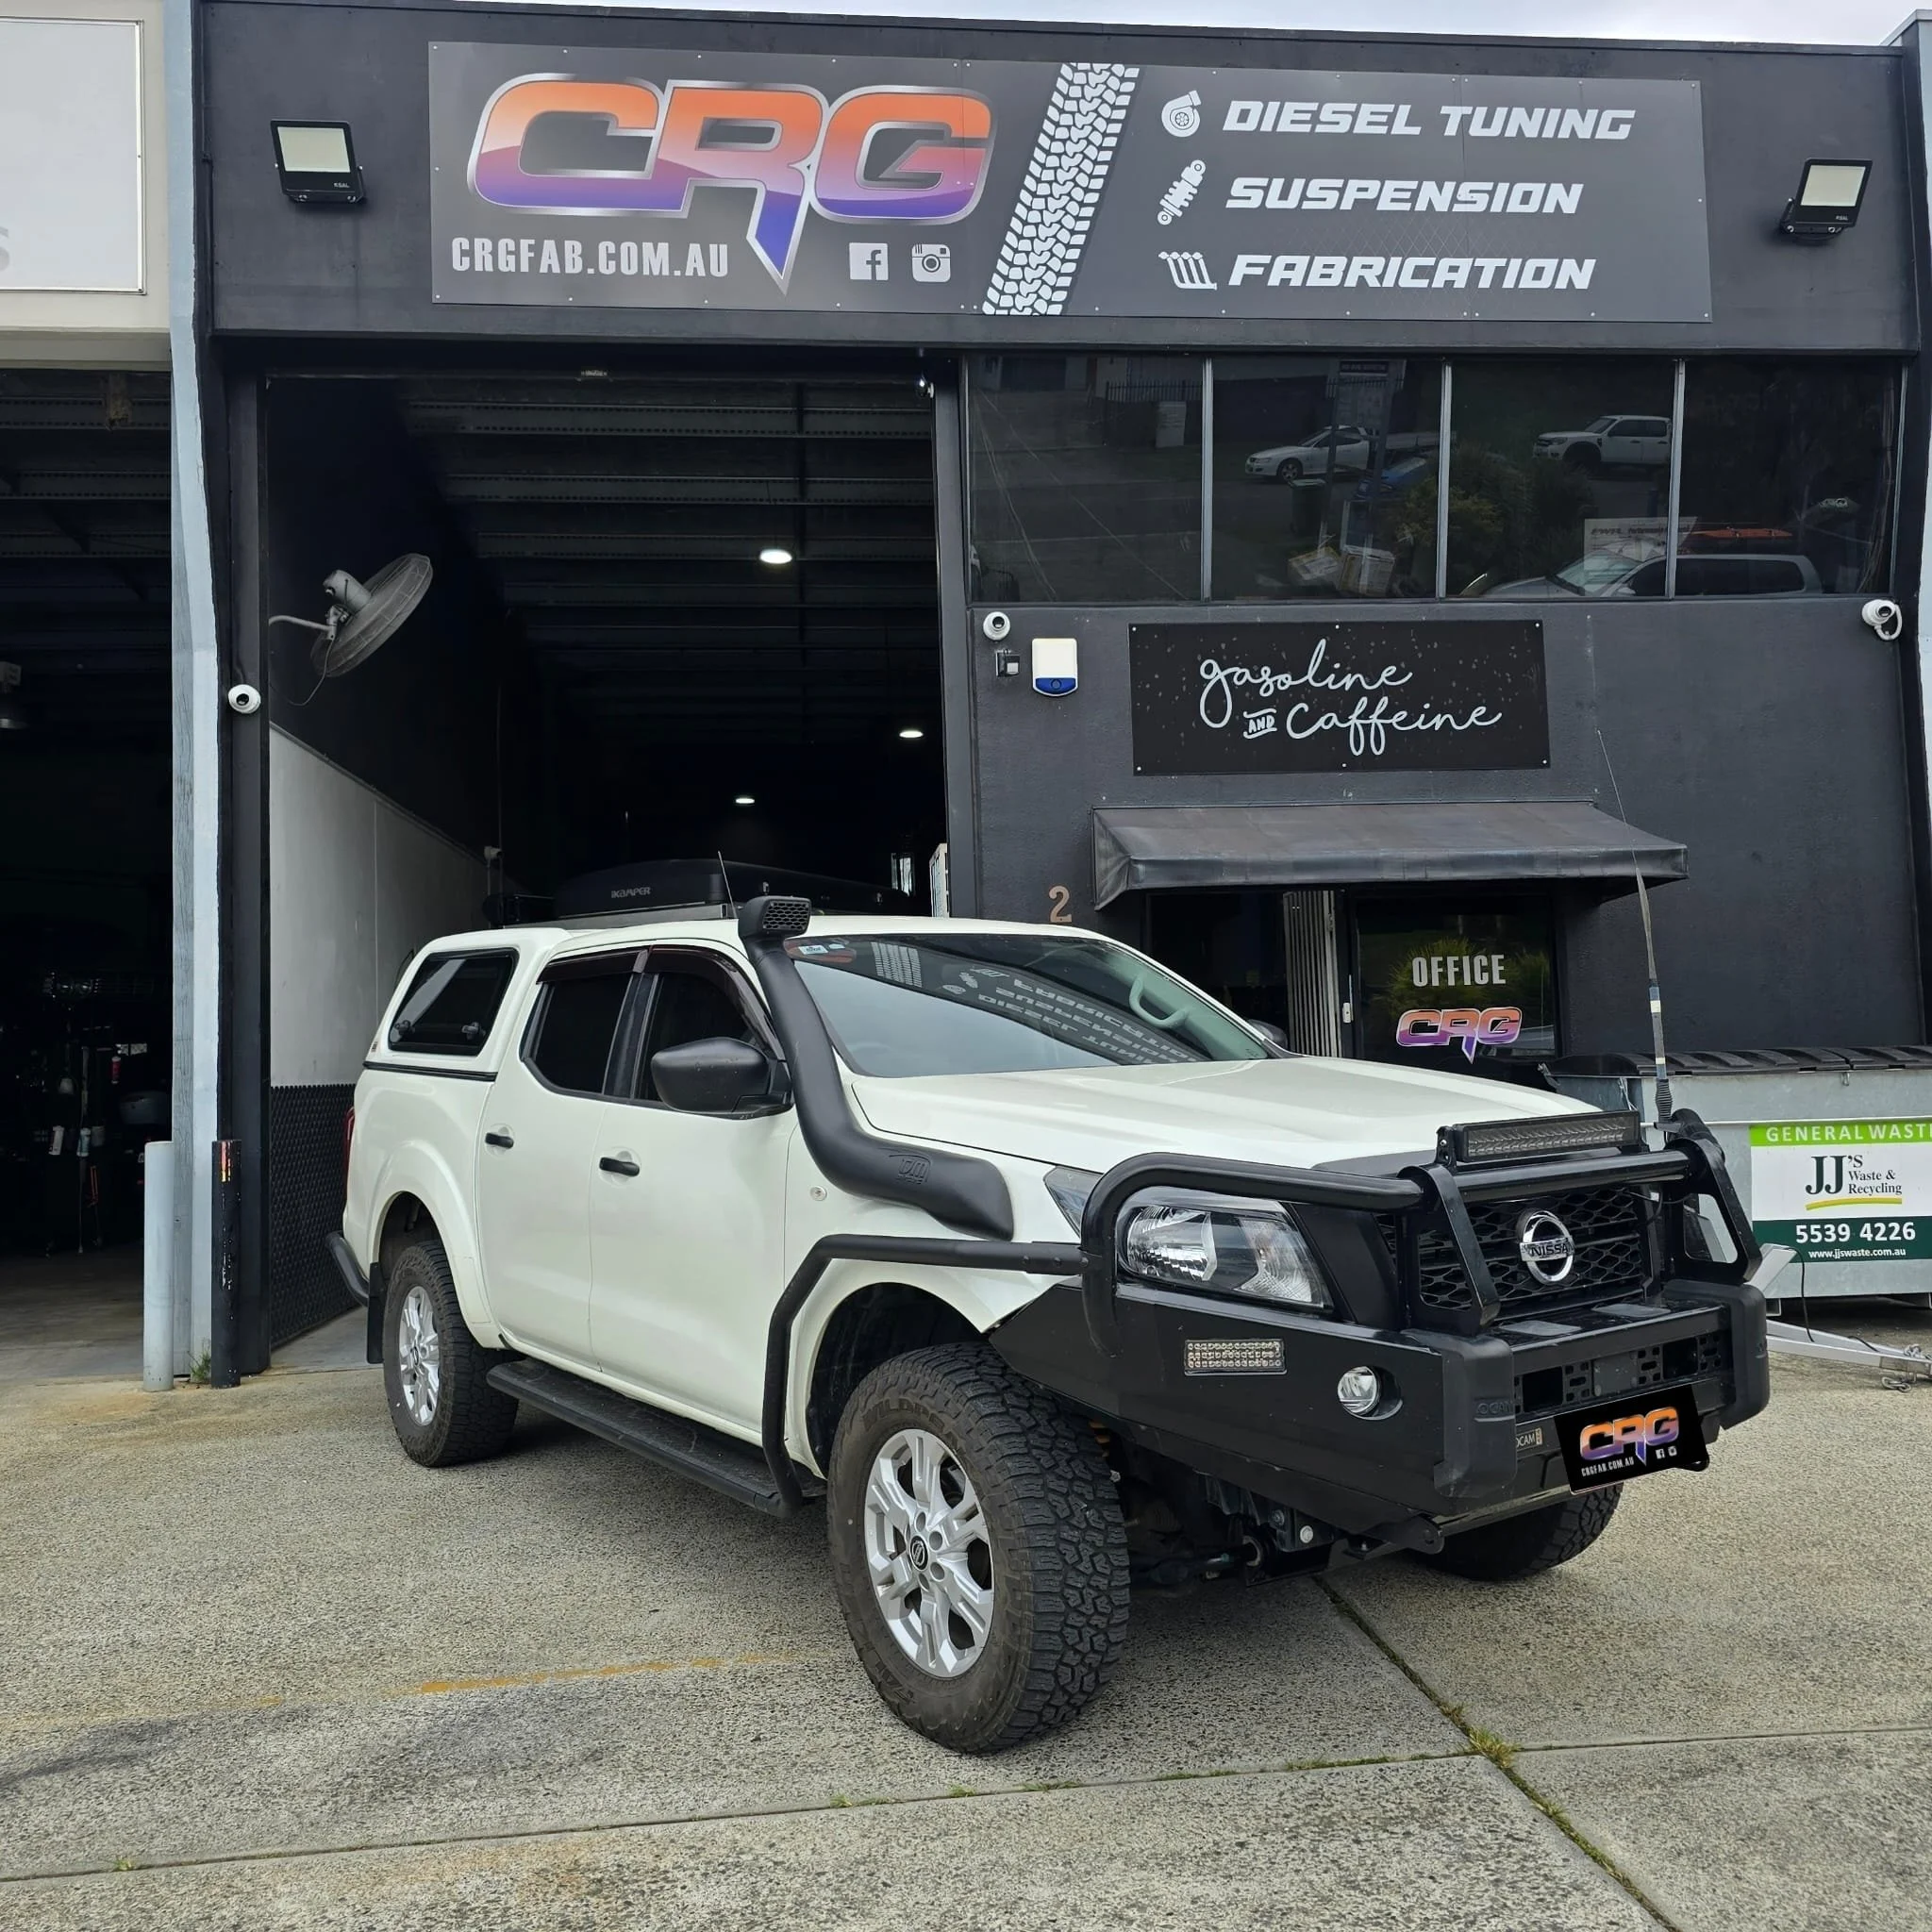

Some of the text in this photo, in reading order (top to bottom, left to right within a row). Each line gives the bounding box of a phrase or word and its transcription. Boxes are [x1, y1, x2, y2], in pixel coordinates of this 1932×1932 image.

[1222, 101, 1636, 141] DIESEL TUNING
[467, 74, 995, 295] CRG
[1225, 176, 1584, 214] SUSPENSION
[452, 237, 728, 277] CRGFAB.COM.AU
[1228, 254, 1596, 290] FABRICATION
[1199, 638, 1412, 728] gasoline
[1248, 714, 1275, 734] AND
[1048, 885, 1073, 923] 2
[1411, 954, 1507, 987] OFFICE
[1395, 1006, 1523, 1065] CRG
[1766, 1123, 1932, 1142] GENERAL WAST
[1848, 1182, 1903, 1196] Recycling
[1849, 1169, 1896, 1181] Waste &
[1795, 1222, 1917, 1243] 5539 4226
[1808, 1248, 1907, 1259] www.jjswaste.com.au
